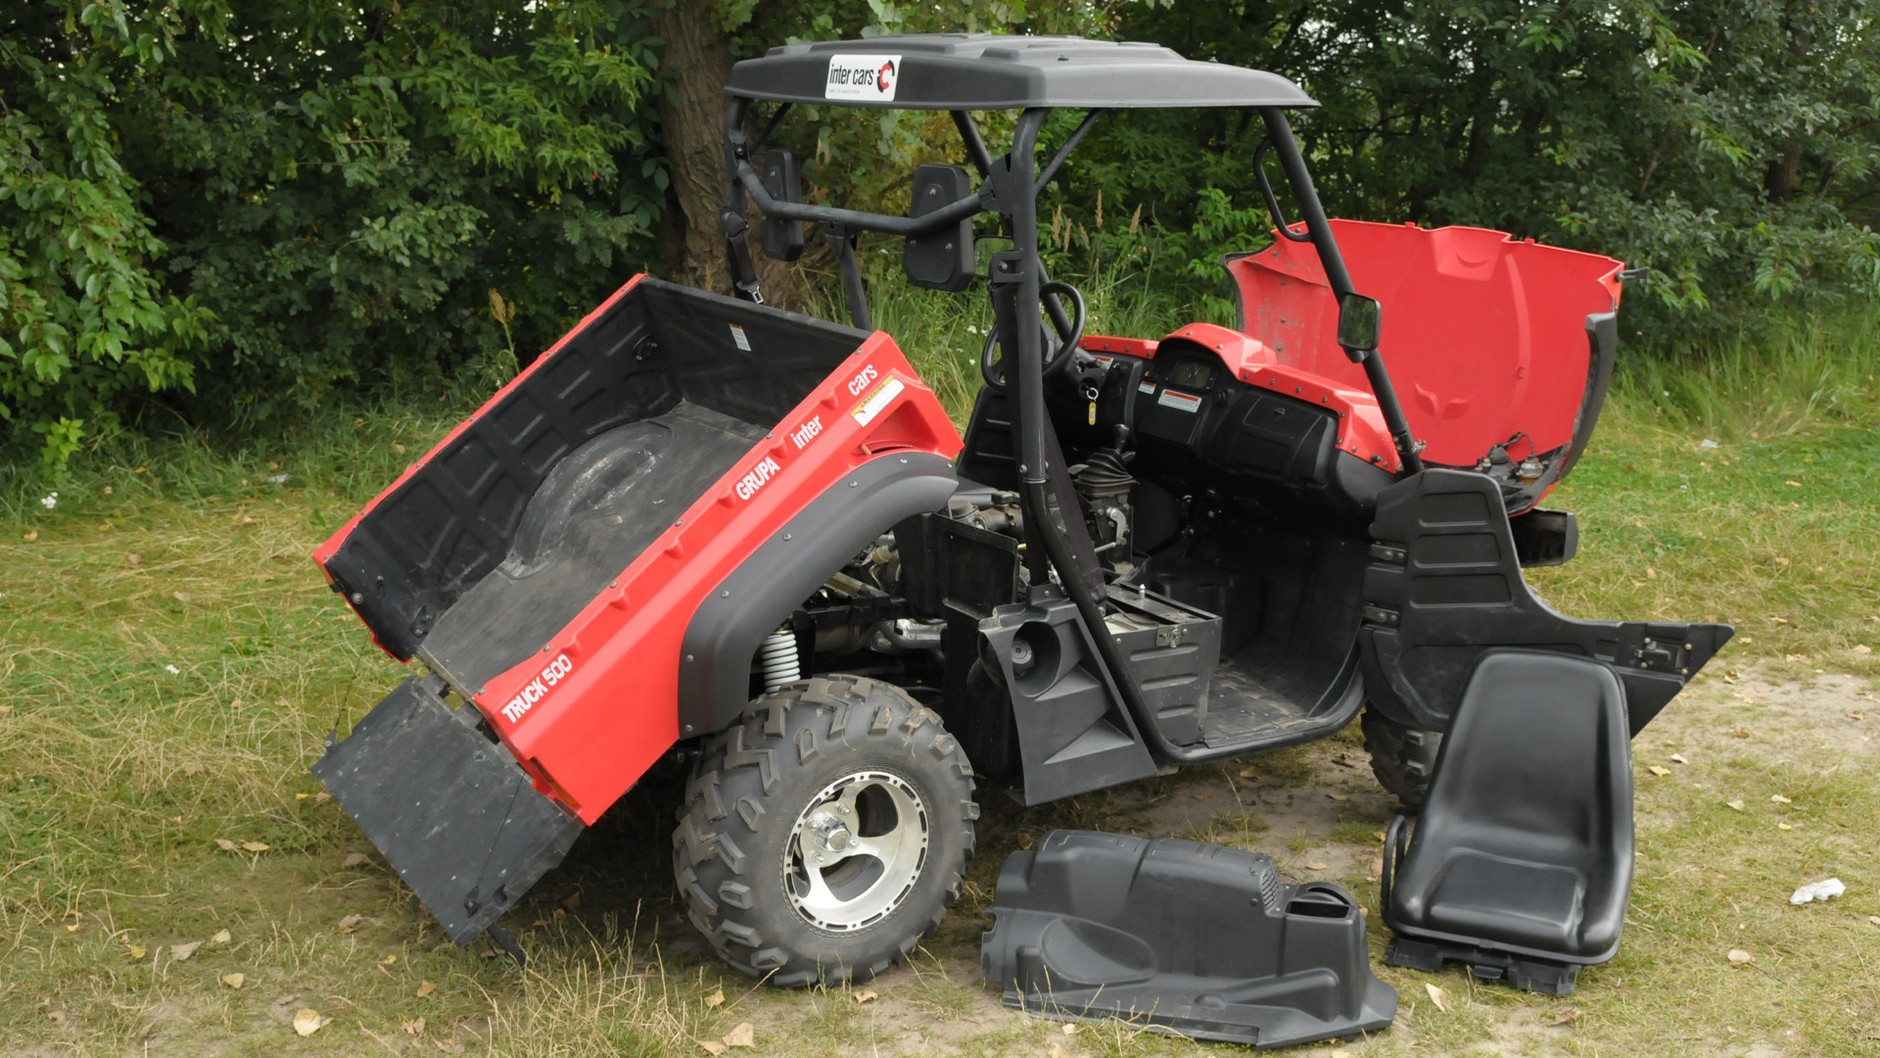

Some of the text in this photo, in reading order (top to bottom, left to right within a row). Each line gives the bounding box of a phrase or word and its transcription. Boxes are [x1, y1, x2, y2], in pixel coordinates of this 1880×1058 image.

[829, 63, 875, 86] inter cars
[735, 364, 878, 501] GRUPA inter cars
[501, 653, 573, 724] TRUCK 500
